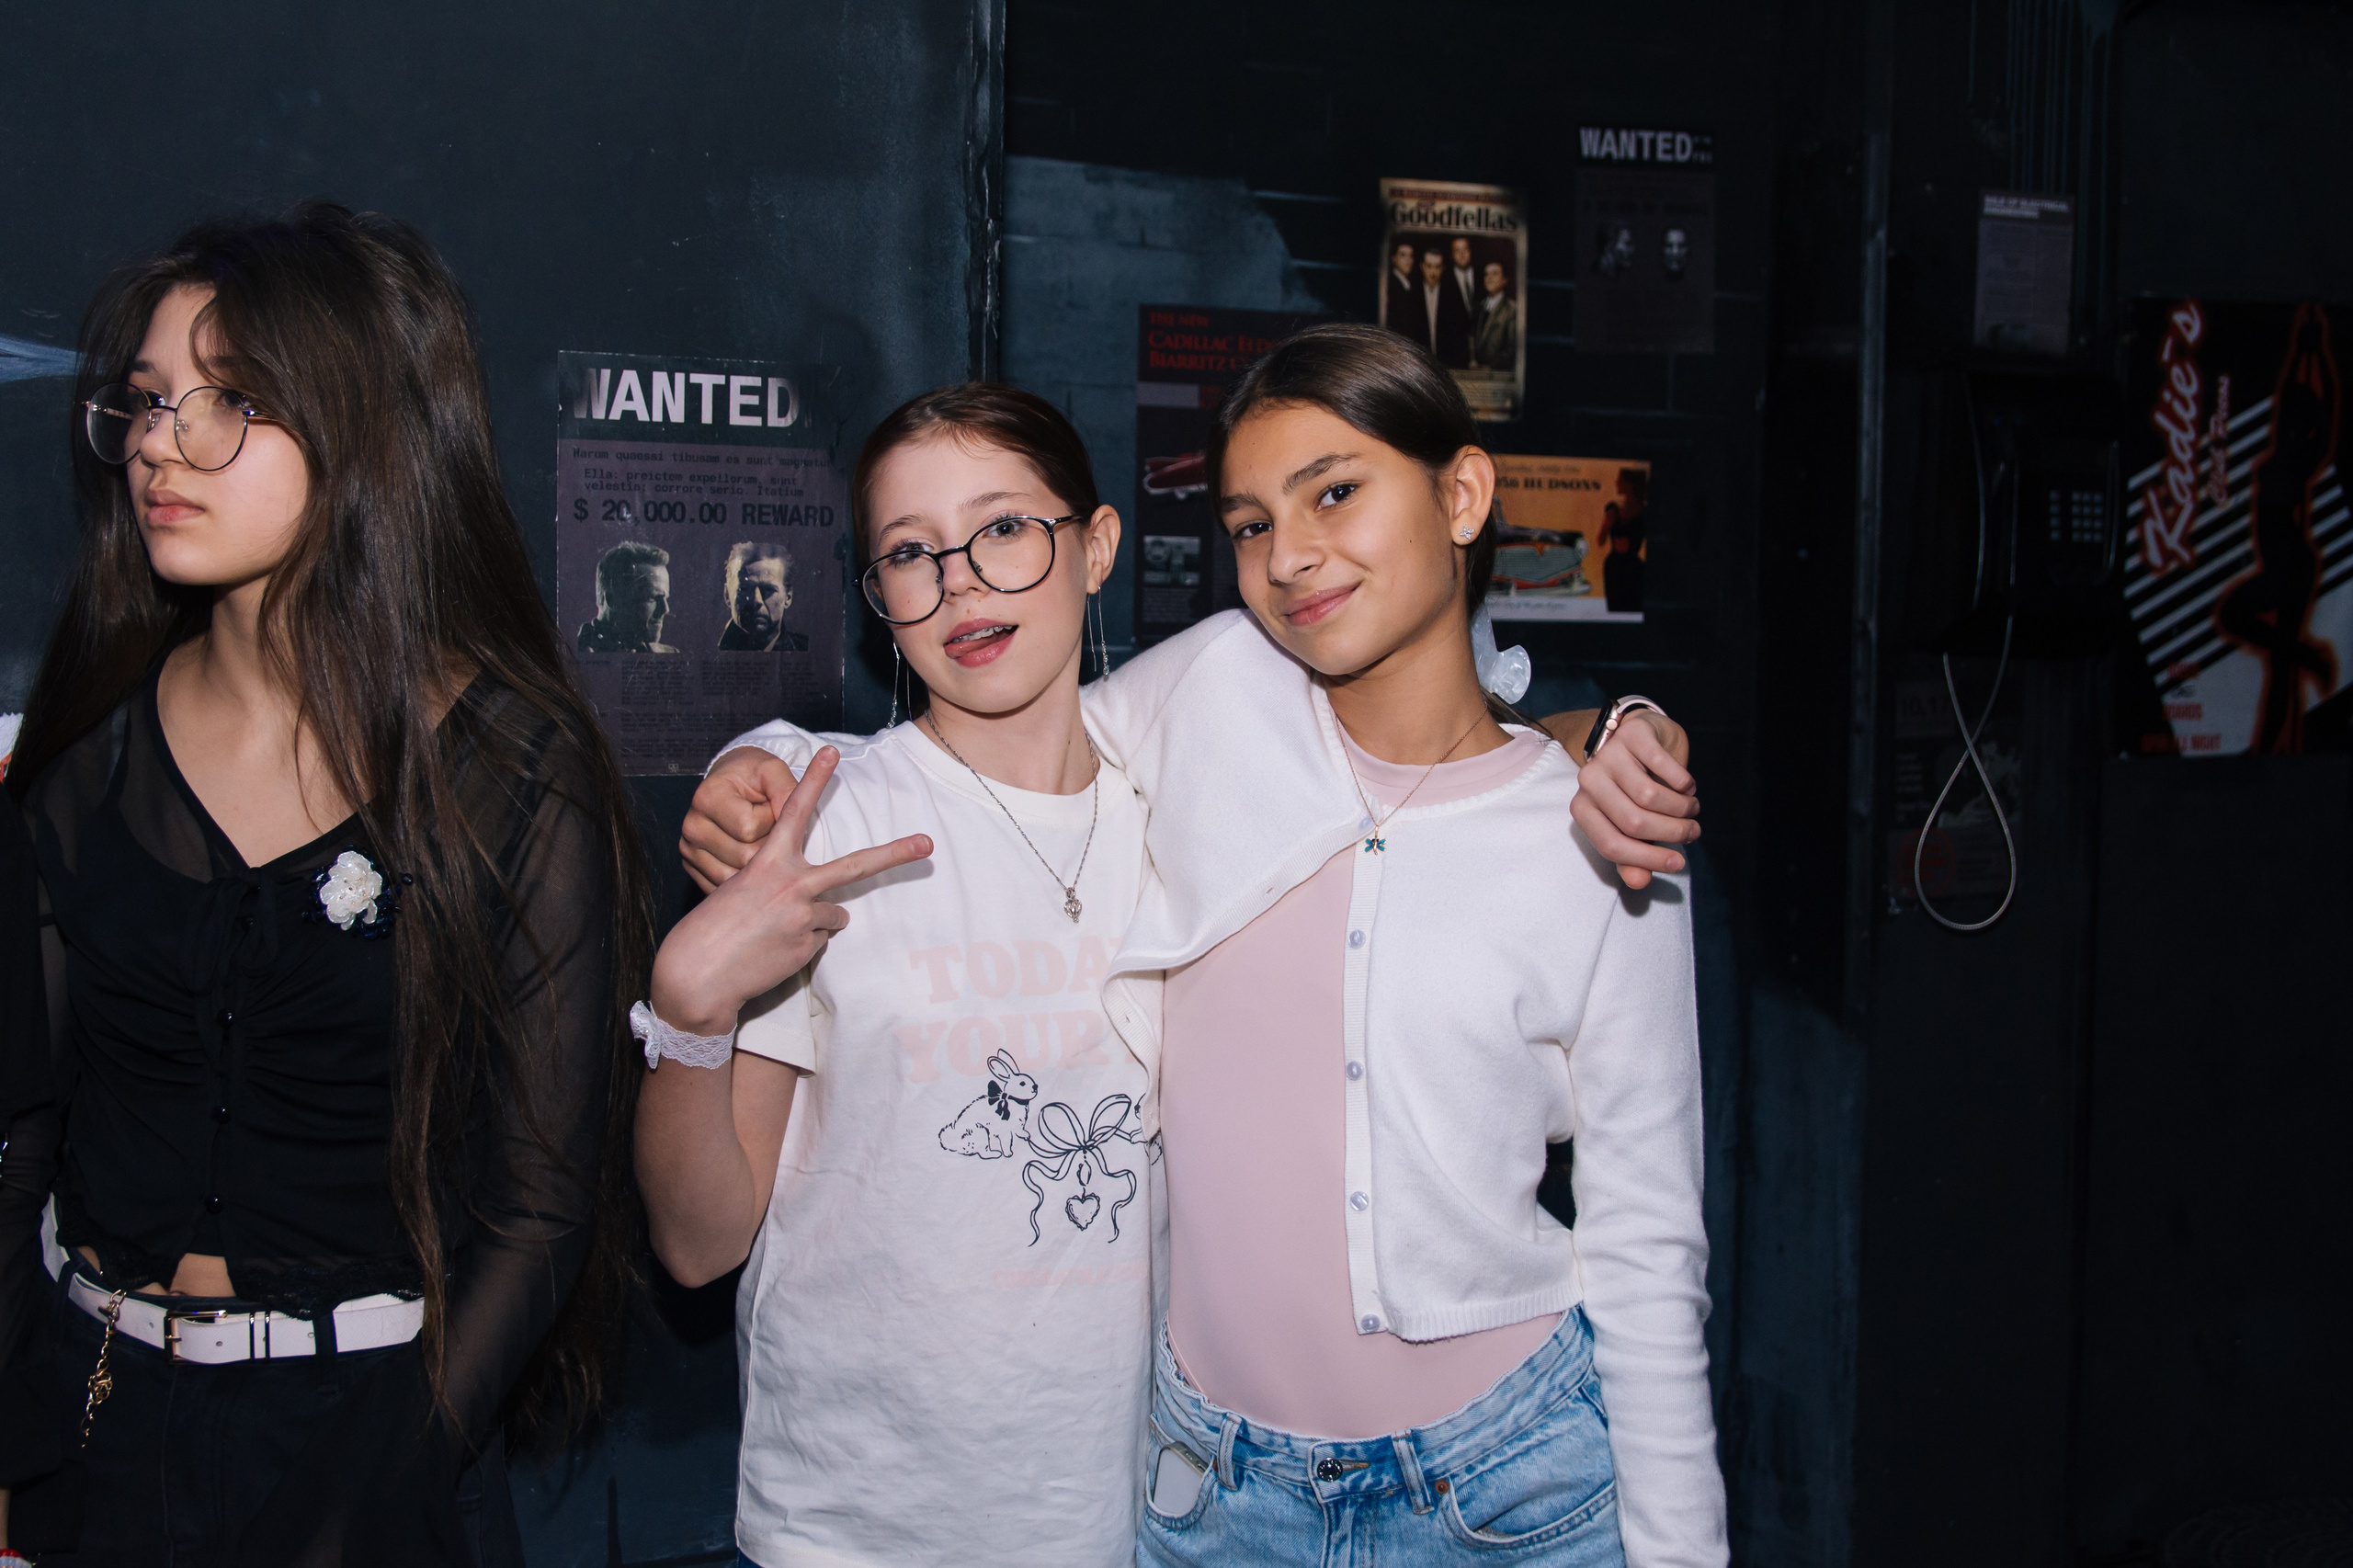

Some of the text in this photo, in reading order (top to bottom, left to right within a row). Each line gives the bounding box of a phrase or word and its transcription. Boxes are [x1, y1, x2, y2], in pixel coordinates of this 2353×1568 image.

[1579, 127, 1693, 163] WANTED
[1391, 199, 1518, 230] Goodfellas
[573, 448, 609, 460] Harum
[574, 497, 589, 523] $
[741, 503, 835, 528] REWARD
[908, 935, 1127, 1006] TODA
